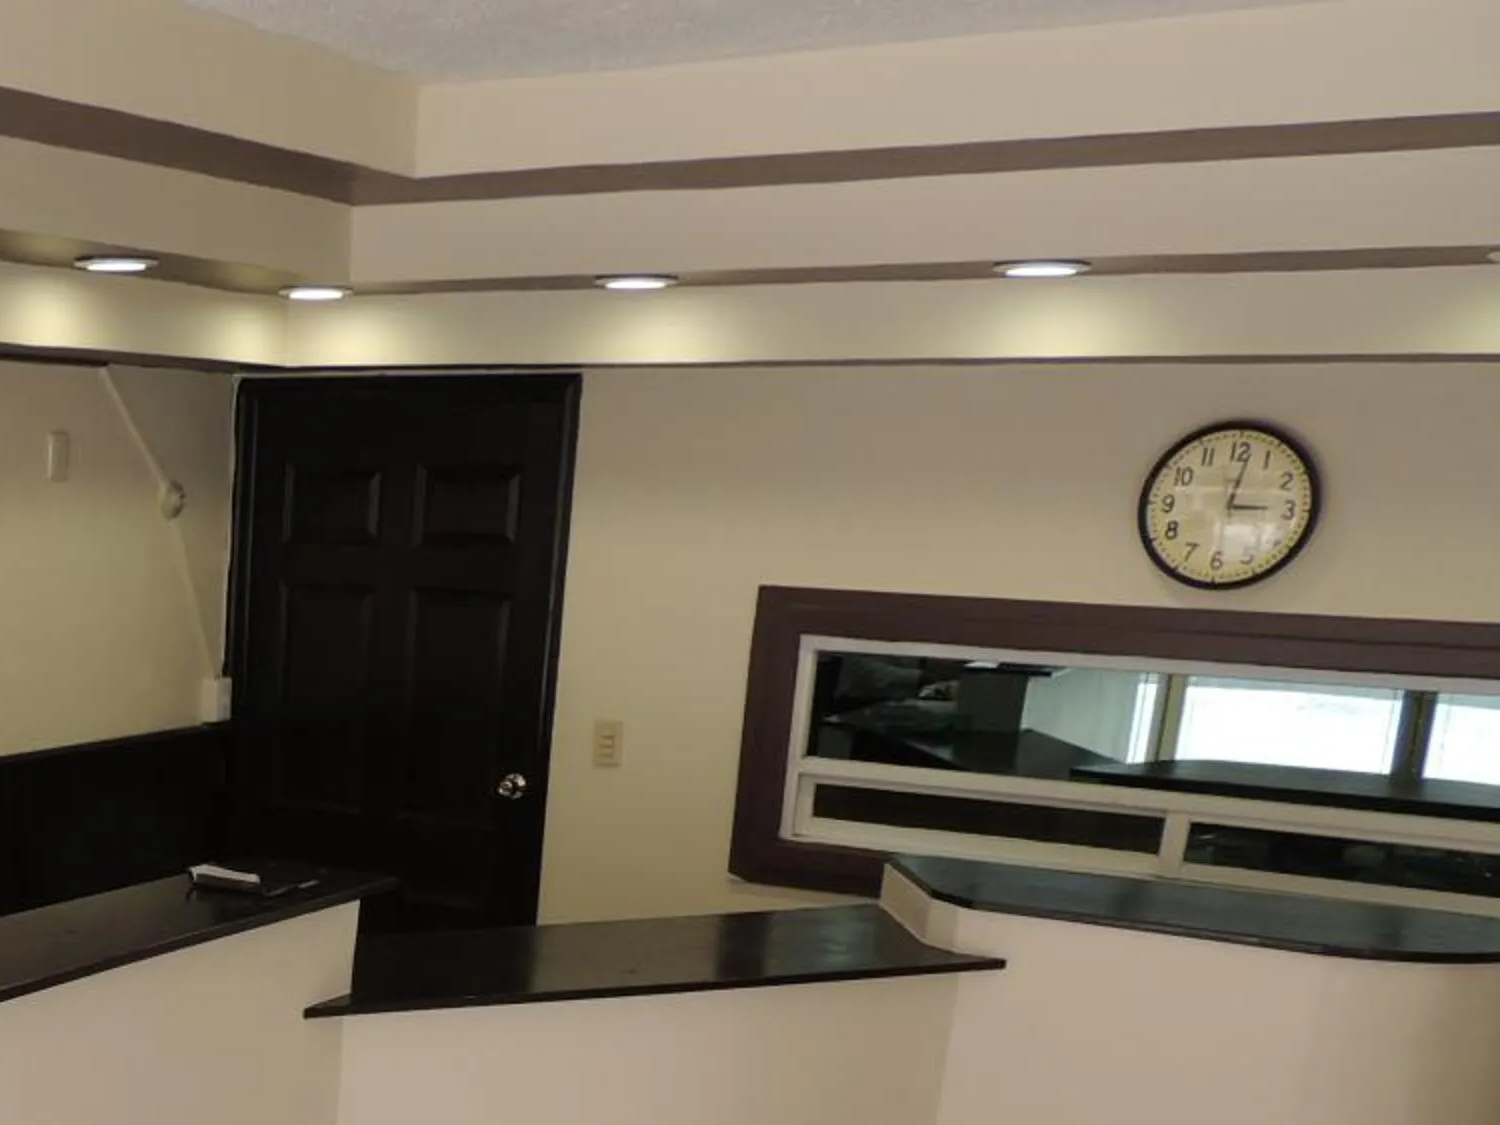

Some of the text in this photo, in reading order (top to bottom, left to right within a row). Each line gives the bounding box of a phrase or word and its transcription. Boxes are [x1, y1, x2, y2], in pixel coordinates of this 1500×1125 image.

[1201, 447, 1215, 467] 11
[1229, 442, 1252, 463] 12
[1263, 450, 1271, 470] 1
[1173, 466, 1194, 487] 10
[1280, 471, 1294, 491] 2
[1161, 494, 1176, 514] 9
[1281, 499, 1296, 520] 3
[1164, 520, 1179, 540] 8
[1183, 542, 1199, 562] 7
[1209, 551, 1224, 570] 6
